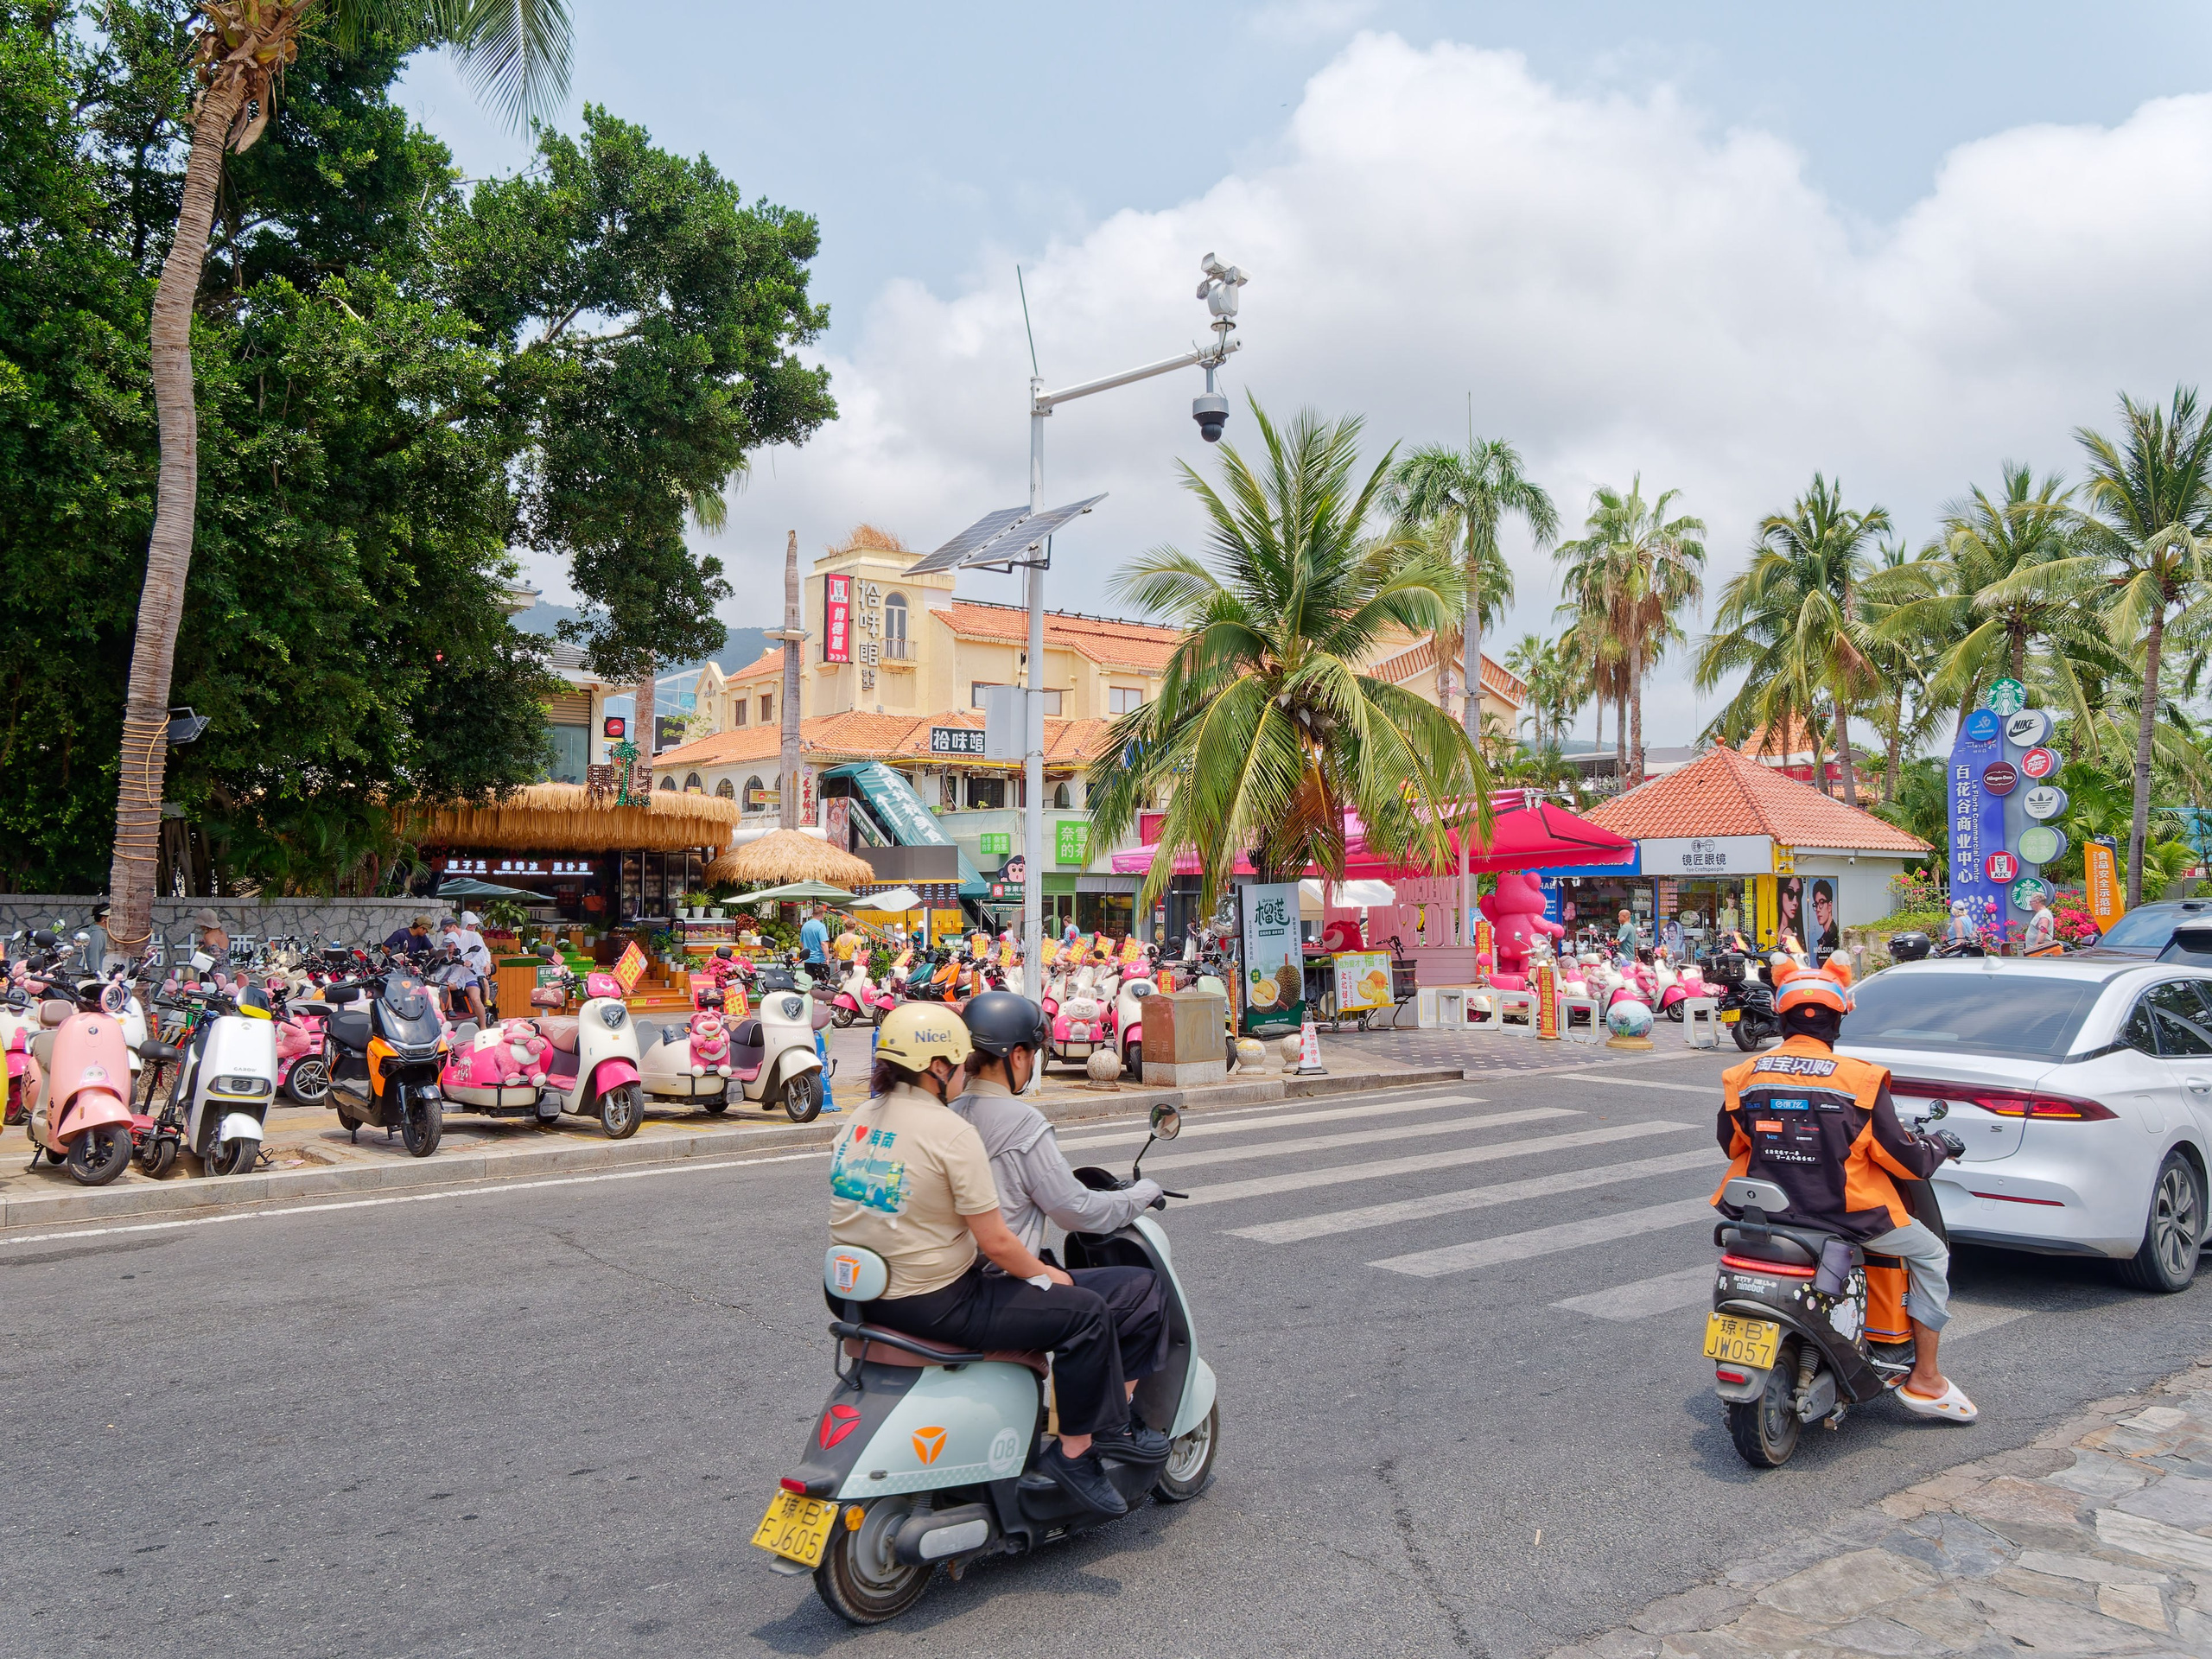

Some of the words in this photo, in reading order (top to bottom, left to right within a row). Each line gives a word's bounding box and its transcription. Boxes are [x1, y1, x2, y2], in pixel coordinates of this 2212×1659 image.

[831, 607, 846, 651] 肯德基
[858, 579, 881, 667] 拾味馆
[2012, 718, 2035, 730] NIKE
[932, 729, 984, 753] 拾味馆
[2027, 760, 2046, 771] Pizza
[2031, 765, 2044, 773] Hut
[1061, 826, 1088, 842] 奈雪
[1955, 764, 1973, 884] 百花谷商业中心
[1681, 853, 1726, 866] 镜匠眼镜
[2098, 851, 2111, 916] 食品安全示范街
[1255, 897, 1291, 926] 榴莲
[973, 941, 988, 956] 租
[1000, 948, 1014, 963] 租
[1041, 944, 1056, 960] 租
[1070, 944, 1085, 959] 租
[1123, 944, 1141, 962] 租
[1813, 945, 1834, 954] MOLSION
[620, 953, 642, 987] 租
[724, 995, 746, 1015] 租
[1541, 967, 1554, 1029] 且行且珍惜电动车租赁
[914, 1029, 952, 1044] Nice!
[1309, 1034, 1318, 1064] 禁止停车
[1753, 1055, 1837, 1077] 淘宝闪购
[867, 1128, 898, 1149] 海南
[1736, 1281, 1765, 1295] ninebot
[1707, 1335, 1770, 1365] JW057
[994, 1438, 1015, 1460] 08
[757, 1517, 822, 1560] FJ605
